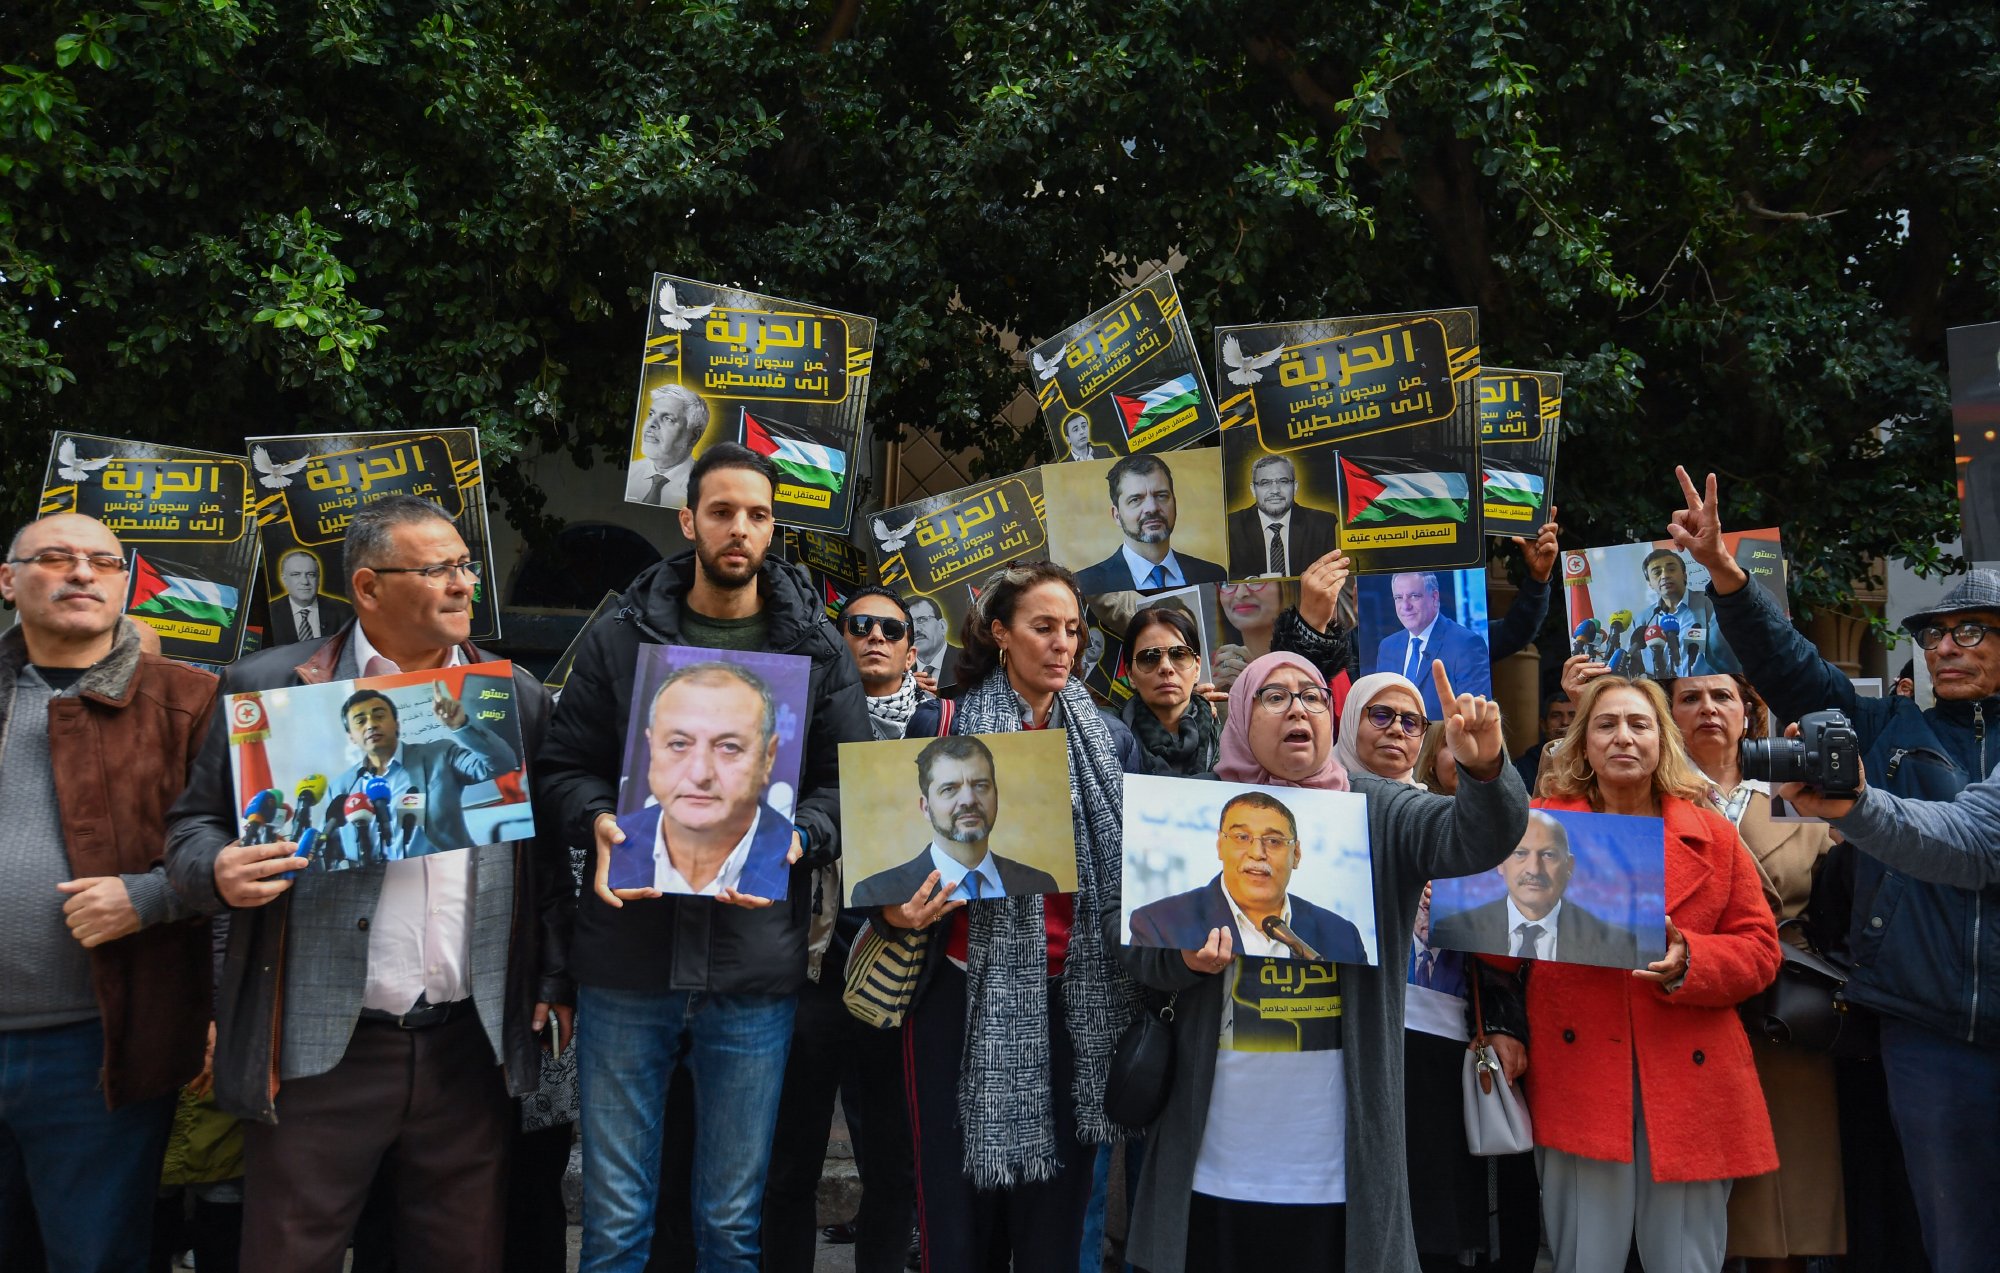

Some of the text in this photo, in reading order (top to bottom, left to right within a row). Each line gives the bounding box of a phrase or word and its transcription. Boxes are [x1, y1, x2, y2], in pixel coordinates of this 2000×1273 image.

[705, 311, 822, 354] الحرية
[1065, 302, 1141, 369] الحرية
[710, 354, 824, 372] من سجون تونس
[1077, 326, 1150, 382] من سجون تونس
[1278, 330, 1415, 392] الحرية
[1079, 333, 1161, 398] إلى فلسطين
[704, 368, 829, 397] إلى فلسطين
[1480, 381, 1520, 403] الح
[1289, 376, 1422, 414] من سجون تونس
[1287, 391, 1434, 440] إلى فلسطين
[1481, 409, 1521, 419] من سج
[1500, 421, 1528, 437] إلى
[306, 445, 425, 494] الحرية
[102, 463, 219, 500] الحرية
[412, 482, 433, 496] من
[104, 500, 220, 514] من سجون تونس
[318, 495, 358, 513] تونس
[794, 490, 827, 502] للمعتقل
[189, 517, 224, 536] إلى
[915, 490, 1009, 548] الحرية
[928, 520, 1018, 565] من سجون تونس
[1347, 527, 1451, 544] للمعتقل الصحبي عتيق
[929, 530, 1031, 583] إلى فلسطين
[1751, 549, 1777, 559] دستور
[1749, 566, 1773, 576] تونس
[178, 625, 212, 636] للمعتقل
[479, 688, 509, 700] دستور
[476, 708, 506, 721] تونس
[1260, 957, 1338, 995] لحرية
